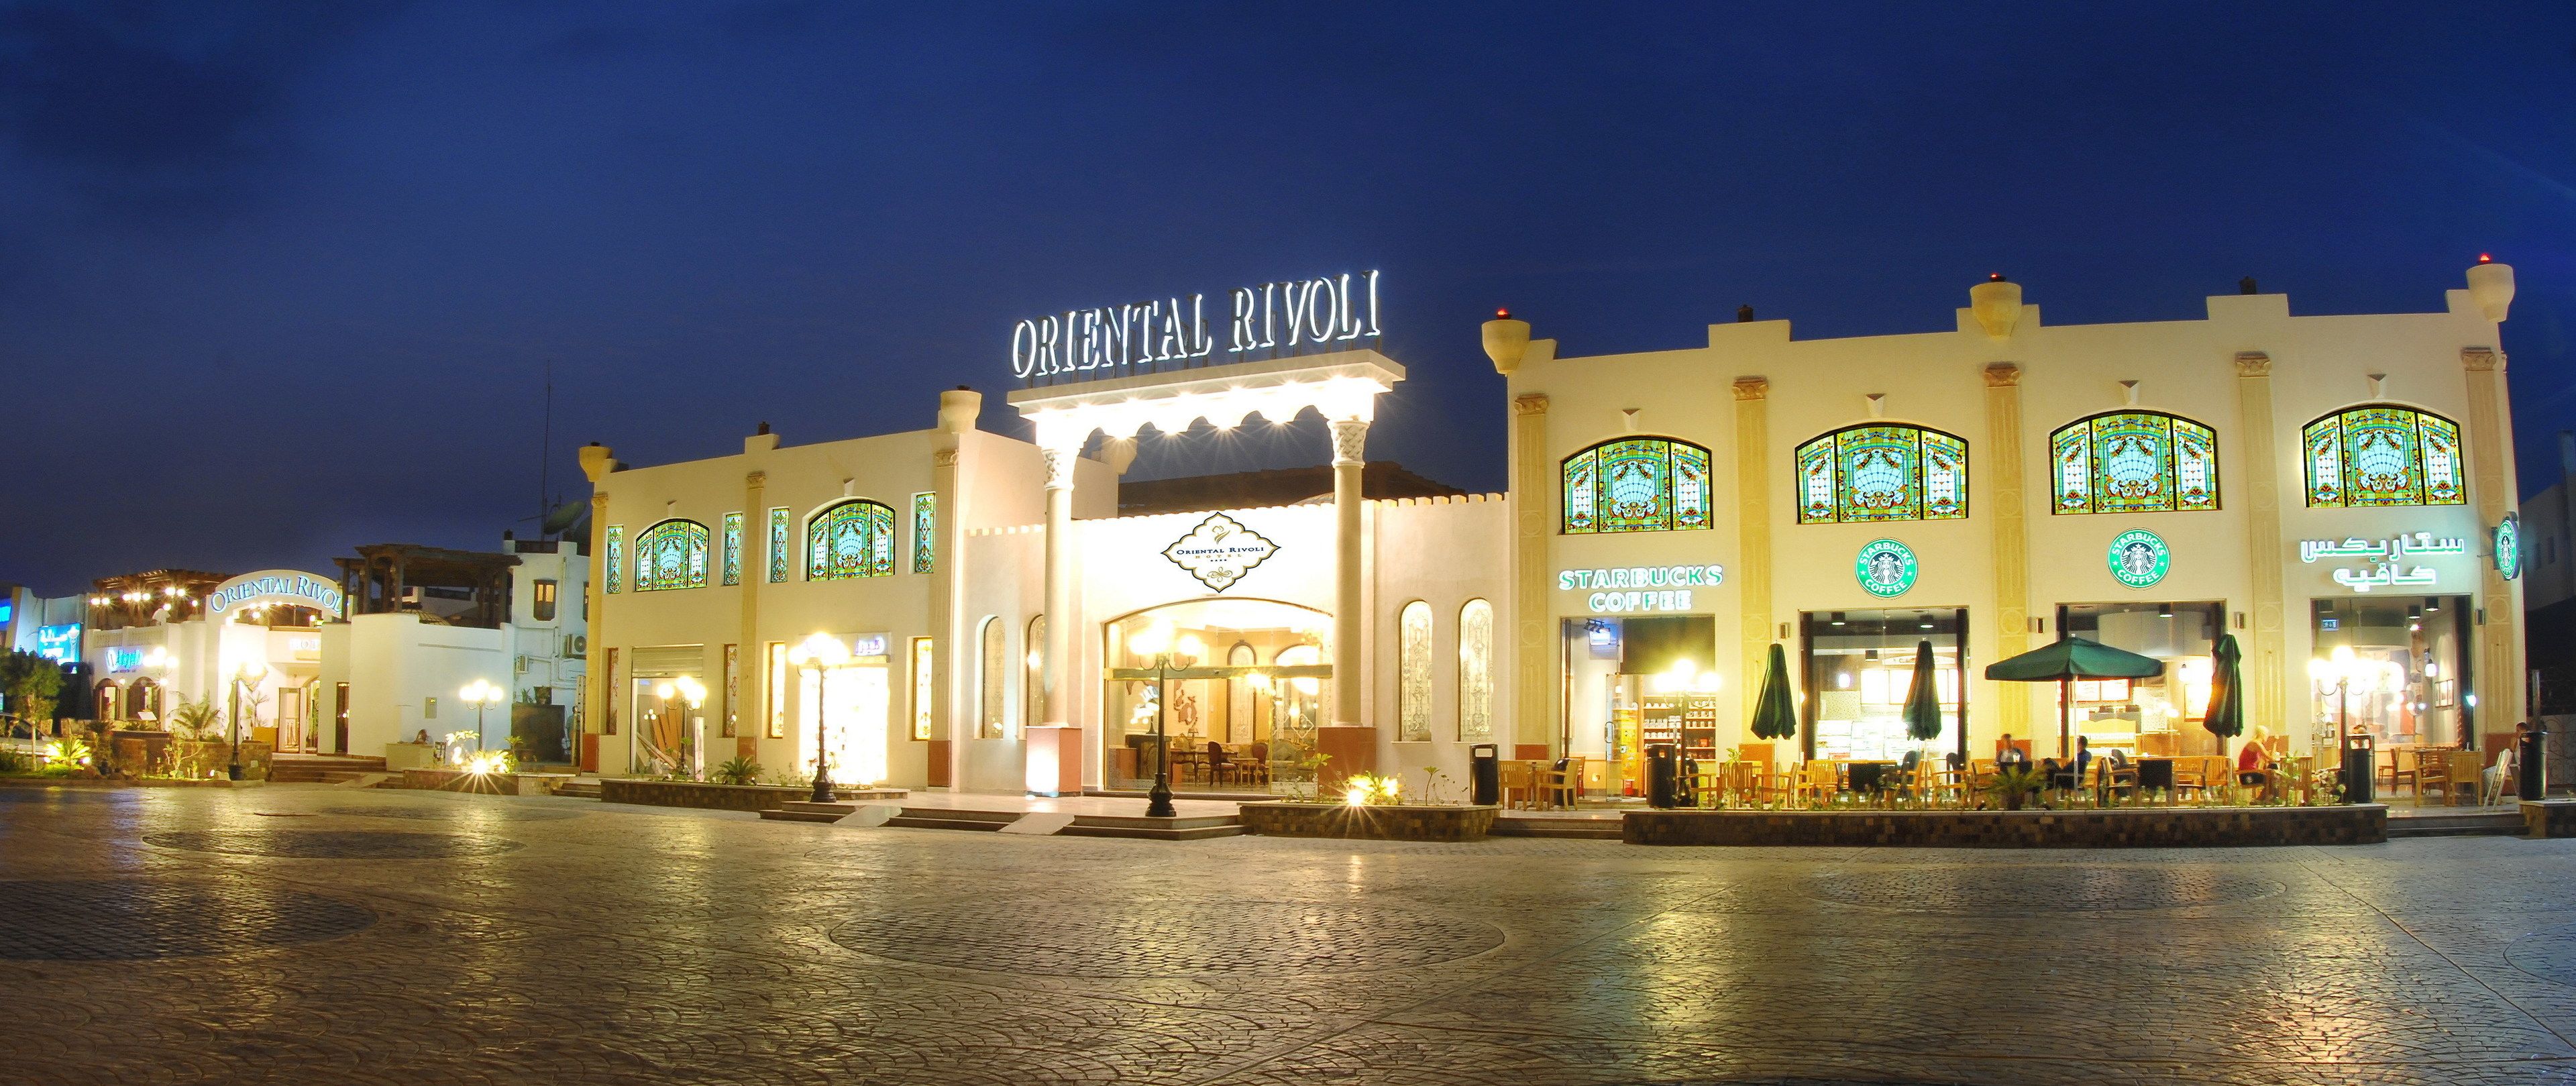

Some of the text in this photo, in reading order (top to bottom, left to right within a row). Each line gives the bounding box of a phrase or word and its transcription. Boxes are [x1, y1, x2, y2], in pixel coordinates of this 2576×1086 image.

[1011, 270, 1381, 378] ORIENTAL RIVOLI
[1859, 542, 1914, 565] STARBUCKS
[2111, 532, 2165, 556] STARBUCKS
[1558, 565, 1723, 591] STARBUCKS
[1865, 580, 1907, 594] COFFEE
[2117, 569, 2160, 584] COFFEE
[2332, 562, 2437, 592] كافيه
[211, 575, 342, 614] ORIENTAL RIVOL
[1588, 589, 1693, 613] COFFEE
